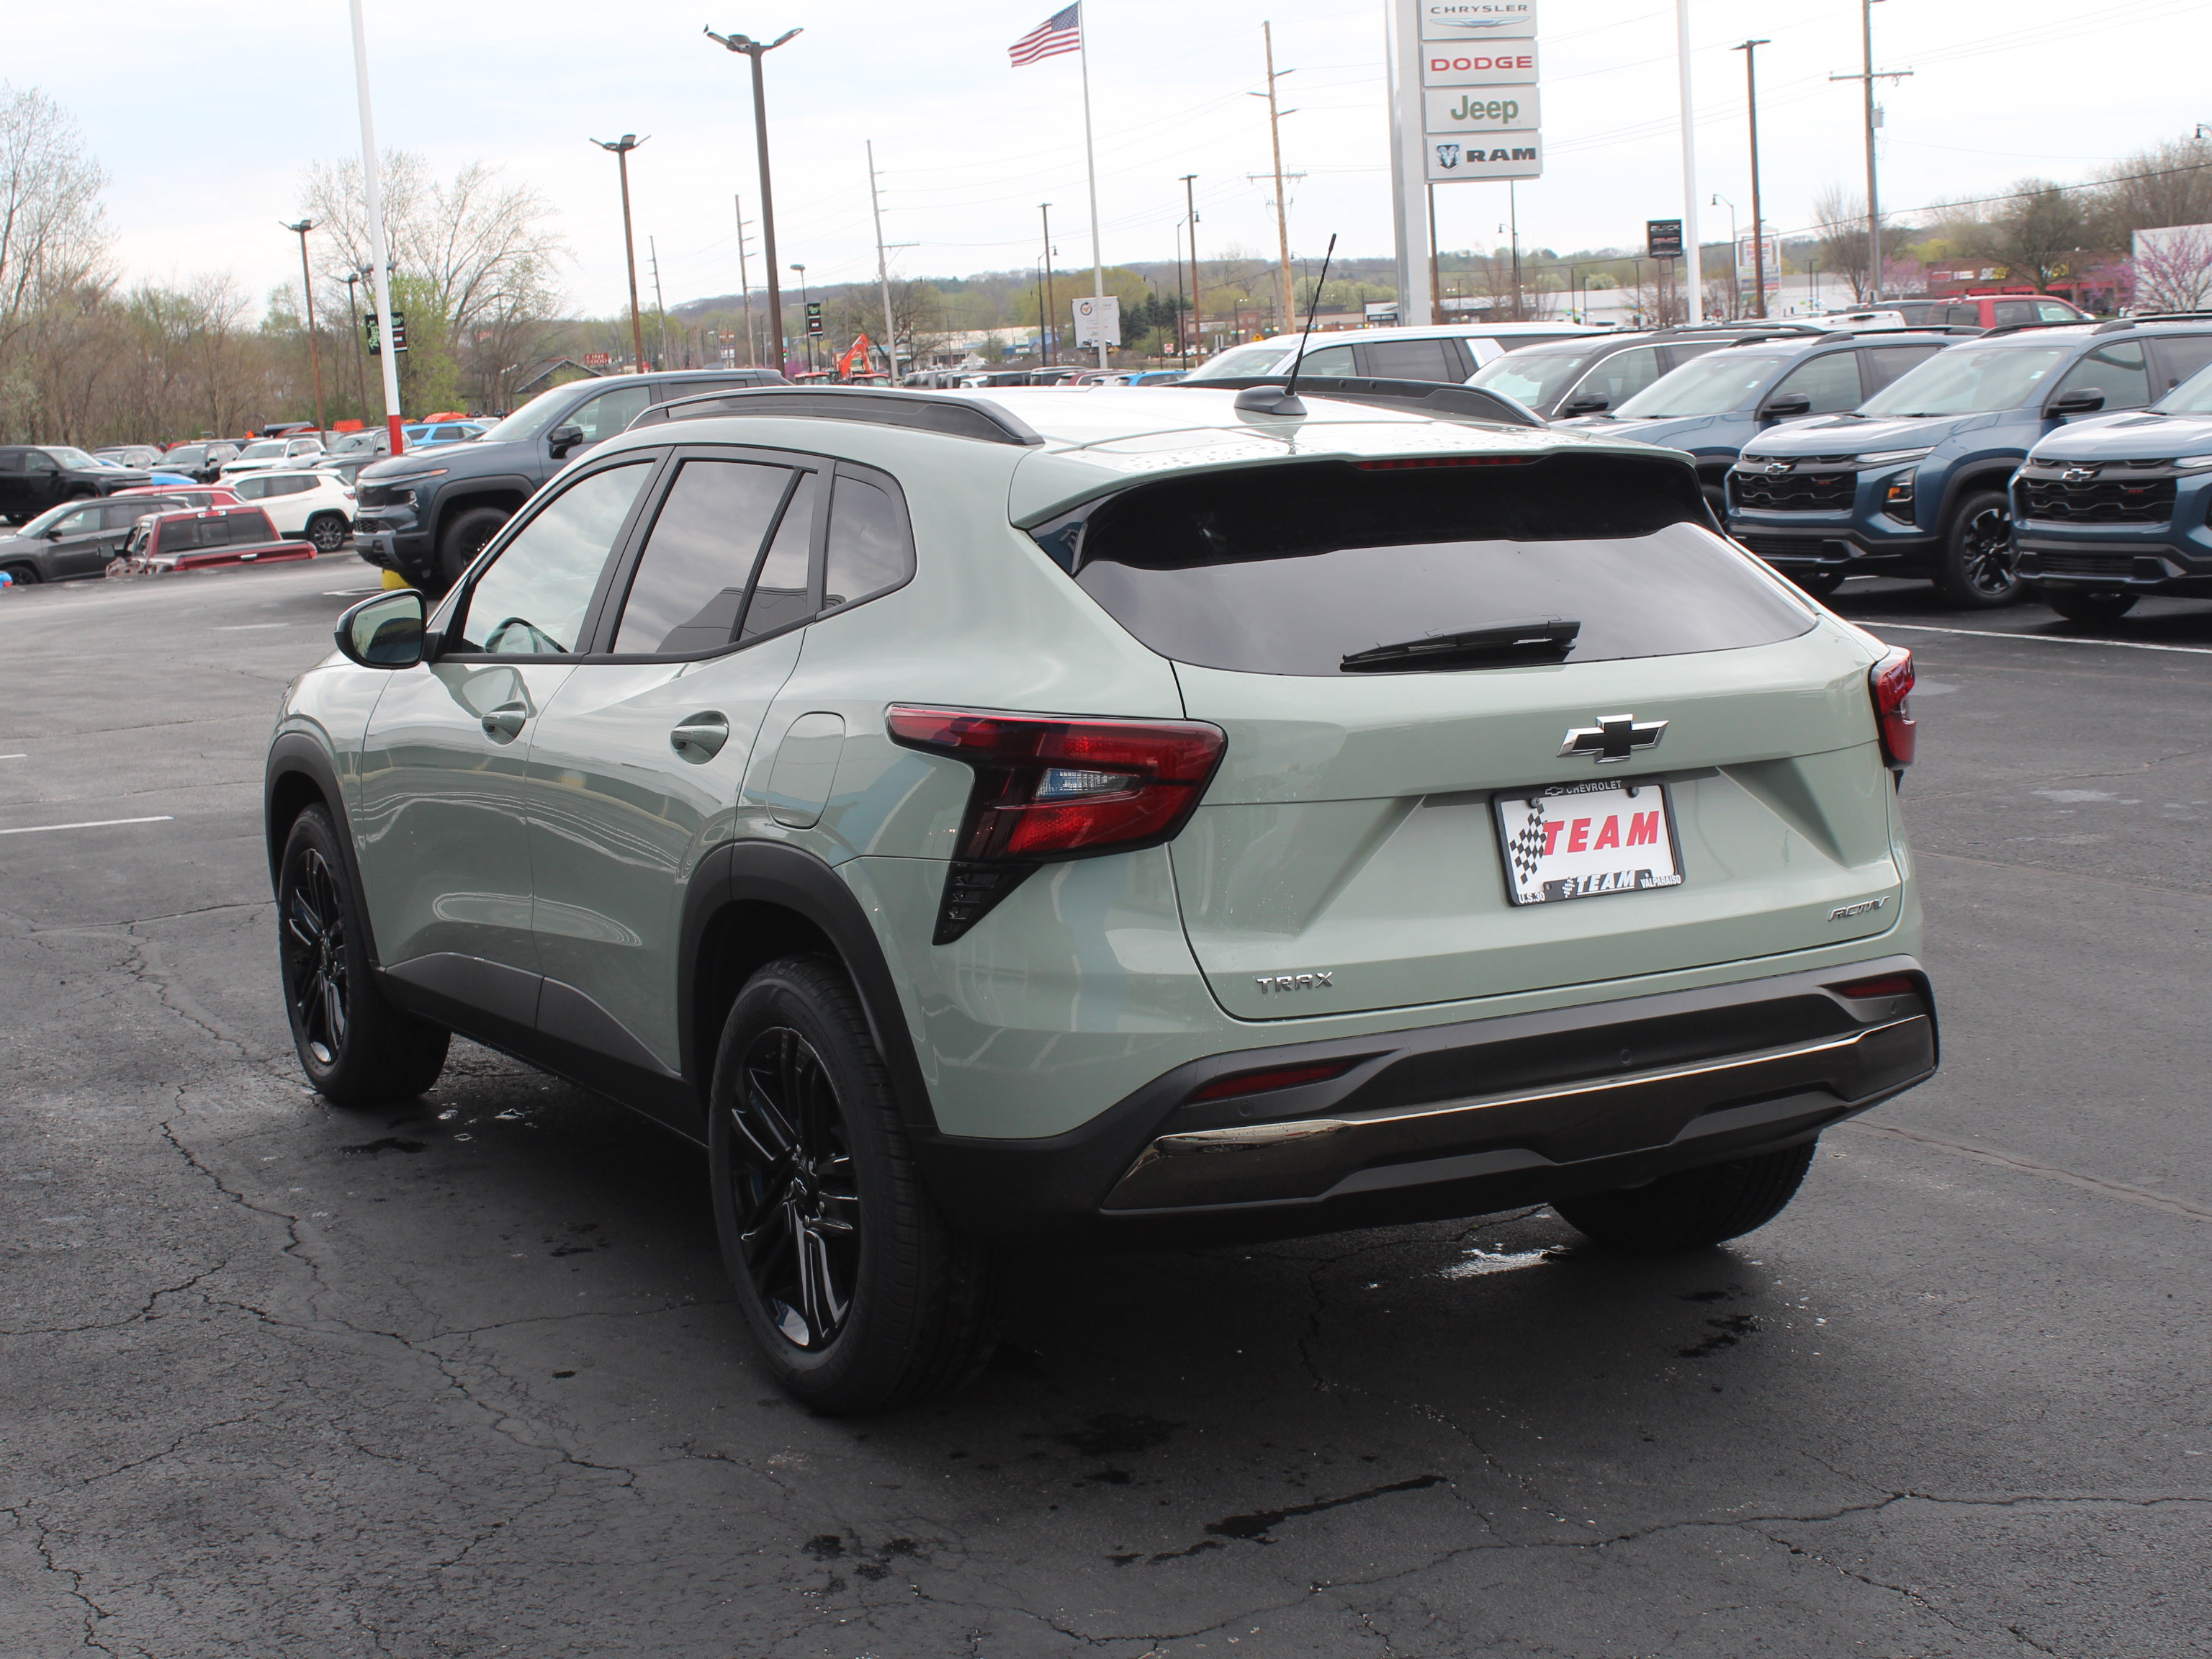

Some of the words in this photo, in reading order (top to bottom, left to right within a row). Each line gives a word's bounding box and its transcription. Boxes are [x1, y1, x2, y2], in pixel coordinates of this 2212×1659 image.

[1430, 4, 1529, 14] CHRYSLER
[1430, 55, 1533, 71] DODGE
[1450, 94, 1519, 125] Jeep
[1466, 147, 1537, 163] RAM
[1542, 810, 1660, 856] TEAM
[1576, 869, 1636, 895] TEAM
[1640, 873, 1682, 889] VALPARAISO
[1827, 895, 1891, 922] ACTIV
[1256, 971, 1334, 994] TRAX
